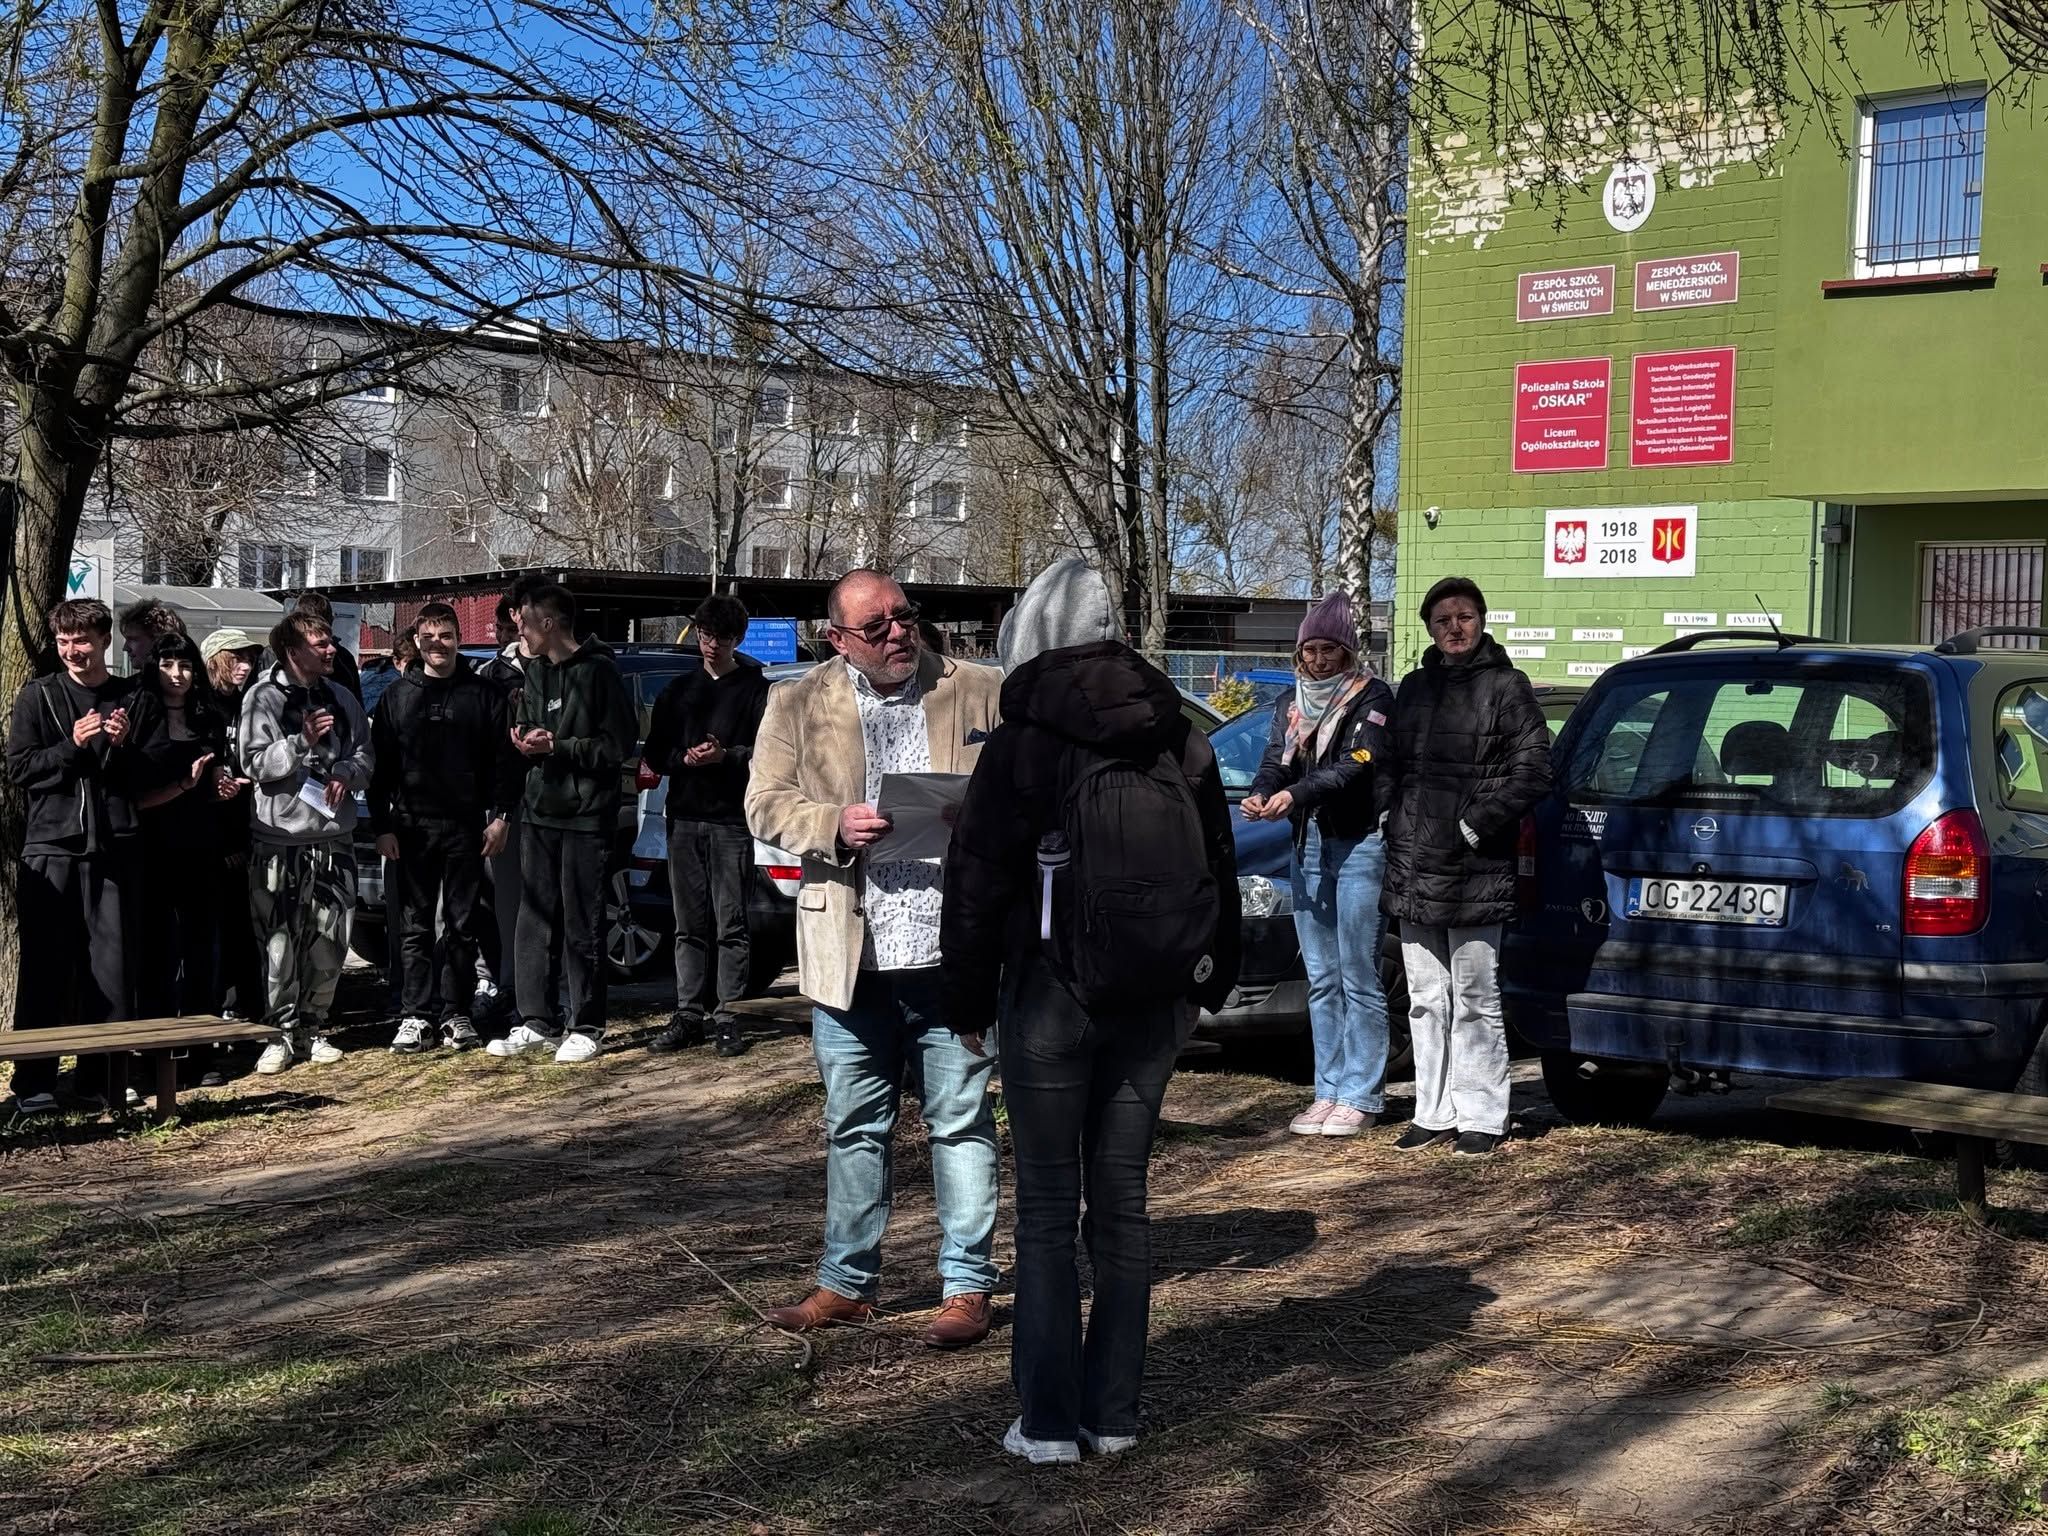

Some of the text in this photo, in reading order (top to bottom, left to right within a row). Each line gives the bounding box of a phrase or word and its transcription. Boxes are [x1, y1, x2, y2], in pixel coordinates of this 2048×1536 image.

[1651, 260, 1723, 279] ZESPÓŁ SZKÓŁ
[1532, 273, 1600, 290] ZESPÓŁ SZKÓŁ
[1646, 274, 1728, 292] MENEDŻERSKICH
[1527, 286, 1604, 303] DLA DOROSŁYCH
[1660, 288, 1712, 303] W ŚWIECIU
[1541, 300, 1590, 314] W ŚWIECIU
[1520, 379, 1605, 393] Policealna Szkoła
[1543, 428, 1577, 438] Liceum
[1601, 521, 1637, 537] 1918
[1599, 548, 1637, 564] 2018
[1691, 615, 1708, 623] 1998
[1629, 897, 1639, 906] PL
[1645, 881, 1777, 916] CG 2243C
